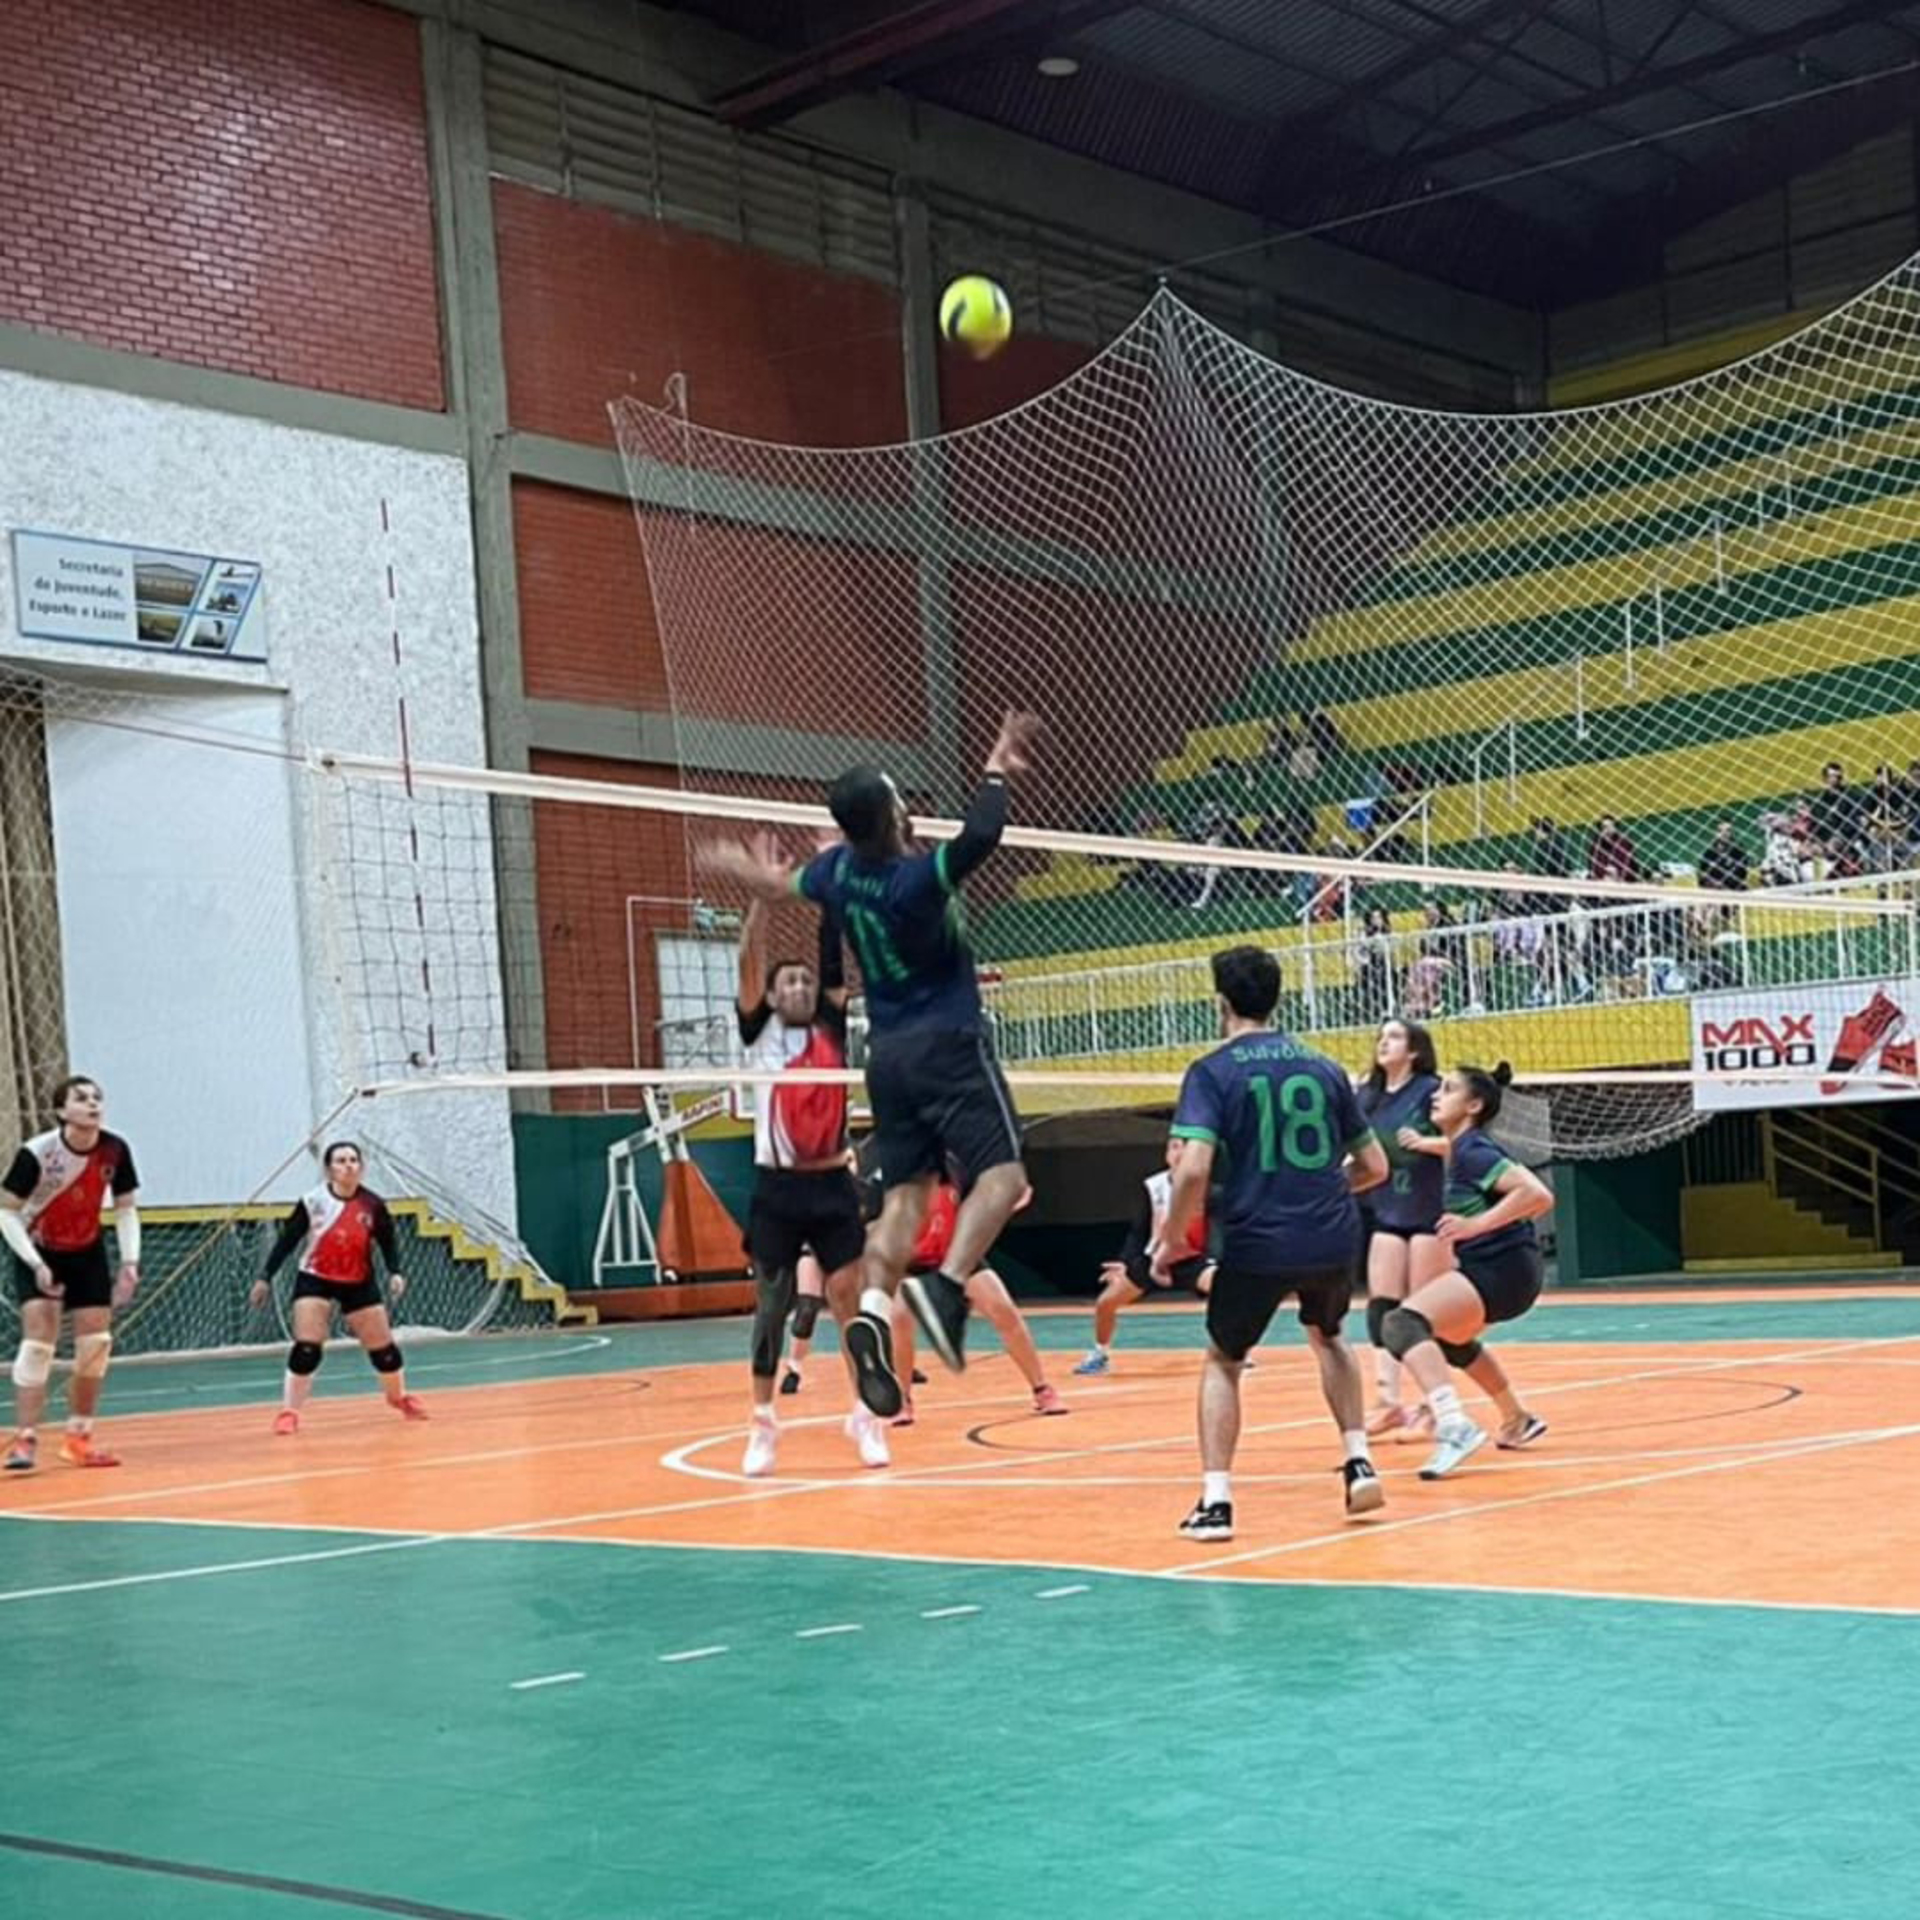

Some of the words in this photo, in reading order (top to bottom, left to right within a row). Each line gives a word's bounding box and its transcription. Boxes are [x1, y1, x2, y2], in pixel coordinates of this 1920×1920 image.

[58, 558, 123, 577] Secretaria
[29, 599, 78, 615] Esporte
[93, 606, 126, 620] Lazer
[1702, 1014, 1814, 1055] MAX
[1705, 1043, 1817, 1071] 1000
[1249, 1074, 1332, 1172] 18
